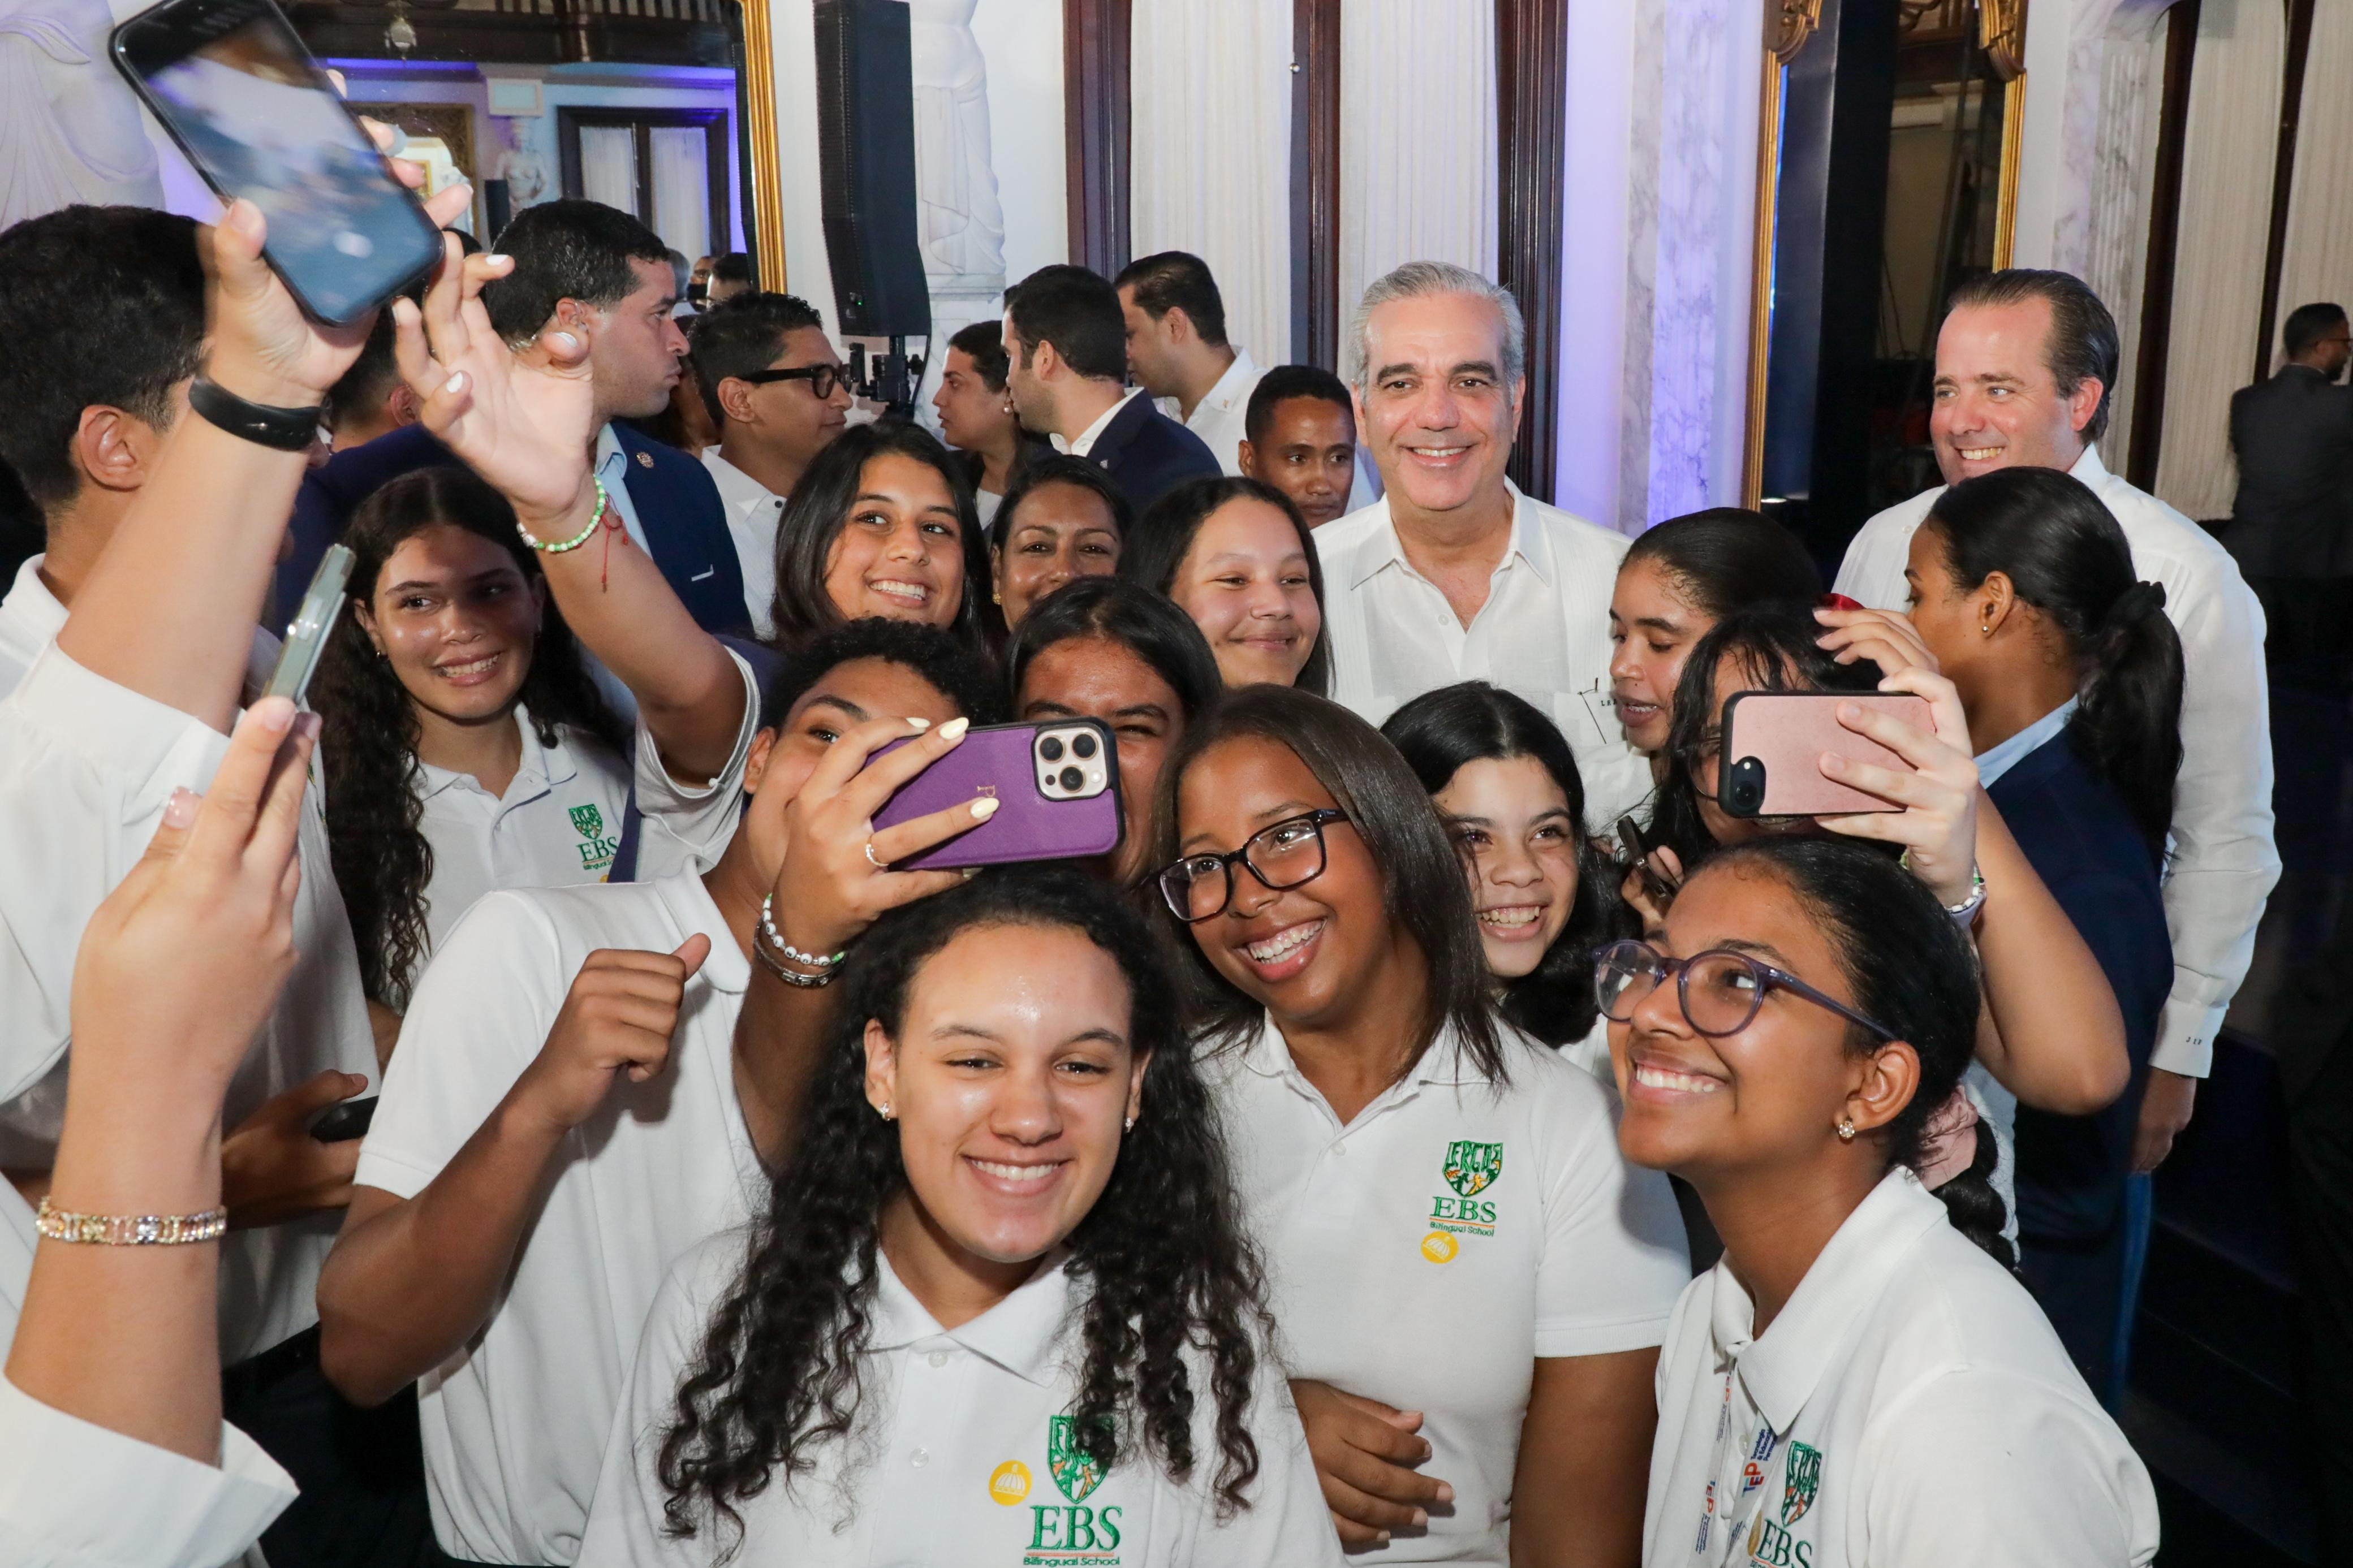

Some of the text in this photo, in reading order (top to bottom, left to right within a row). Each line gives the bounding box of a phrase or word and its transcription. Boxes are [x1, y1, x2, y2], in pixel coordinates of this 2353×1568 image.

[576, 836, 618, 862] EBS
[1429, 1196, 1497, 1223] EBS
[1430, 1221, 1495, 1237] Bilingual School
[1025, 1505, 1122, 1552] EBS
[1755, 1518, 1812, 1568] EBS
[1023, 1556, 1120, 1567] Bilingual School
